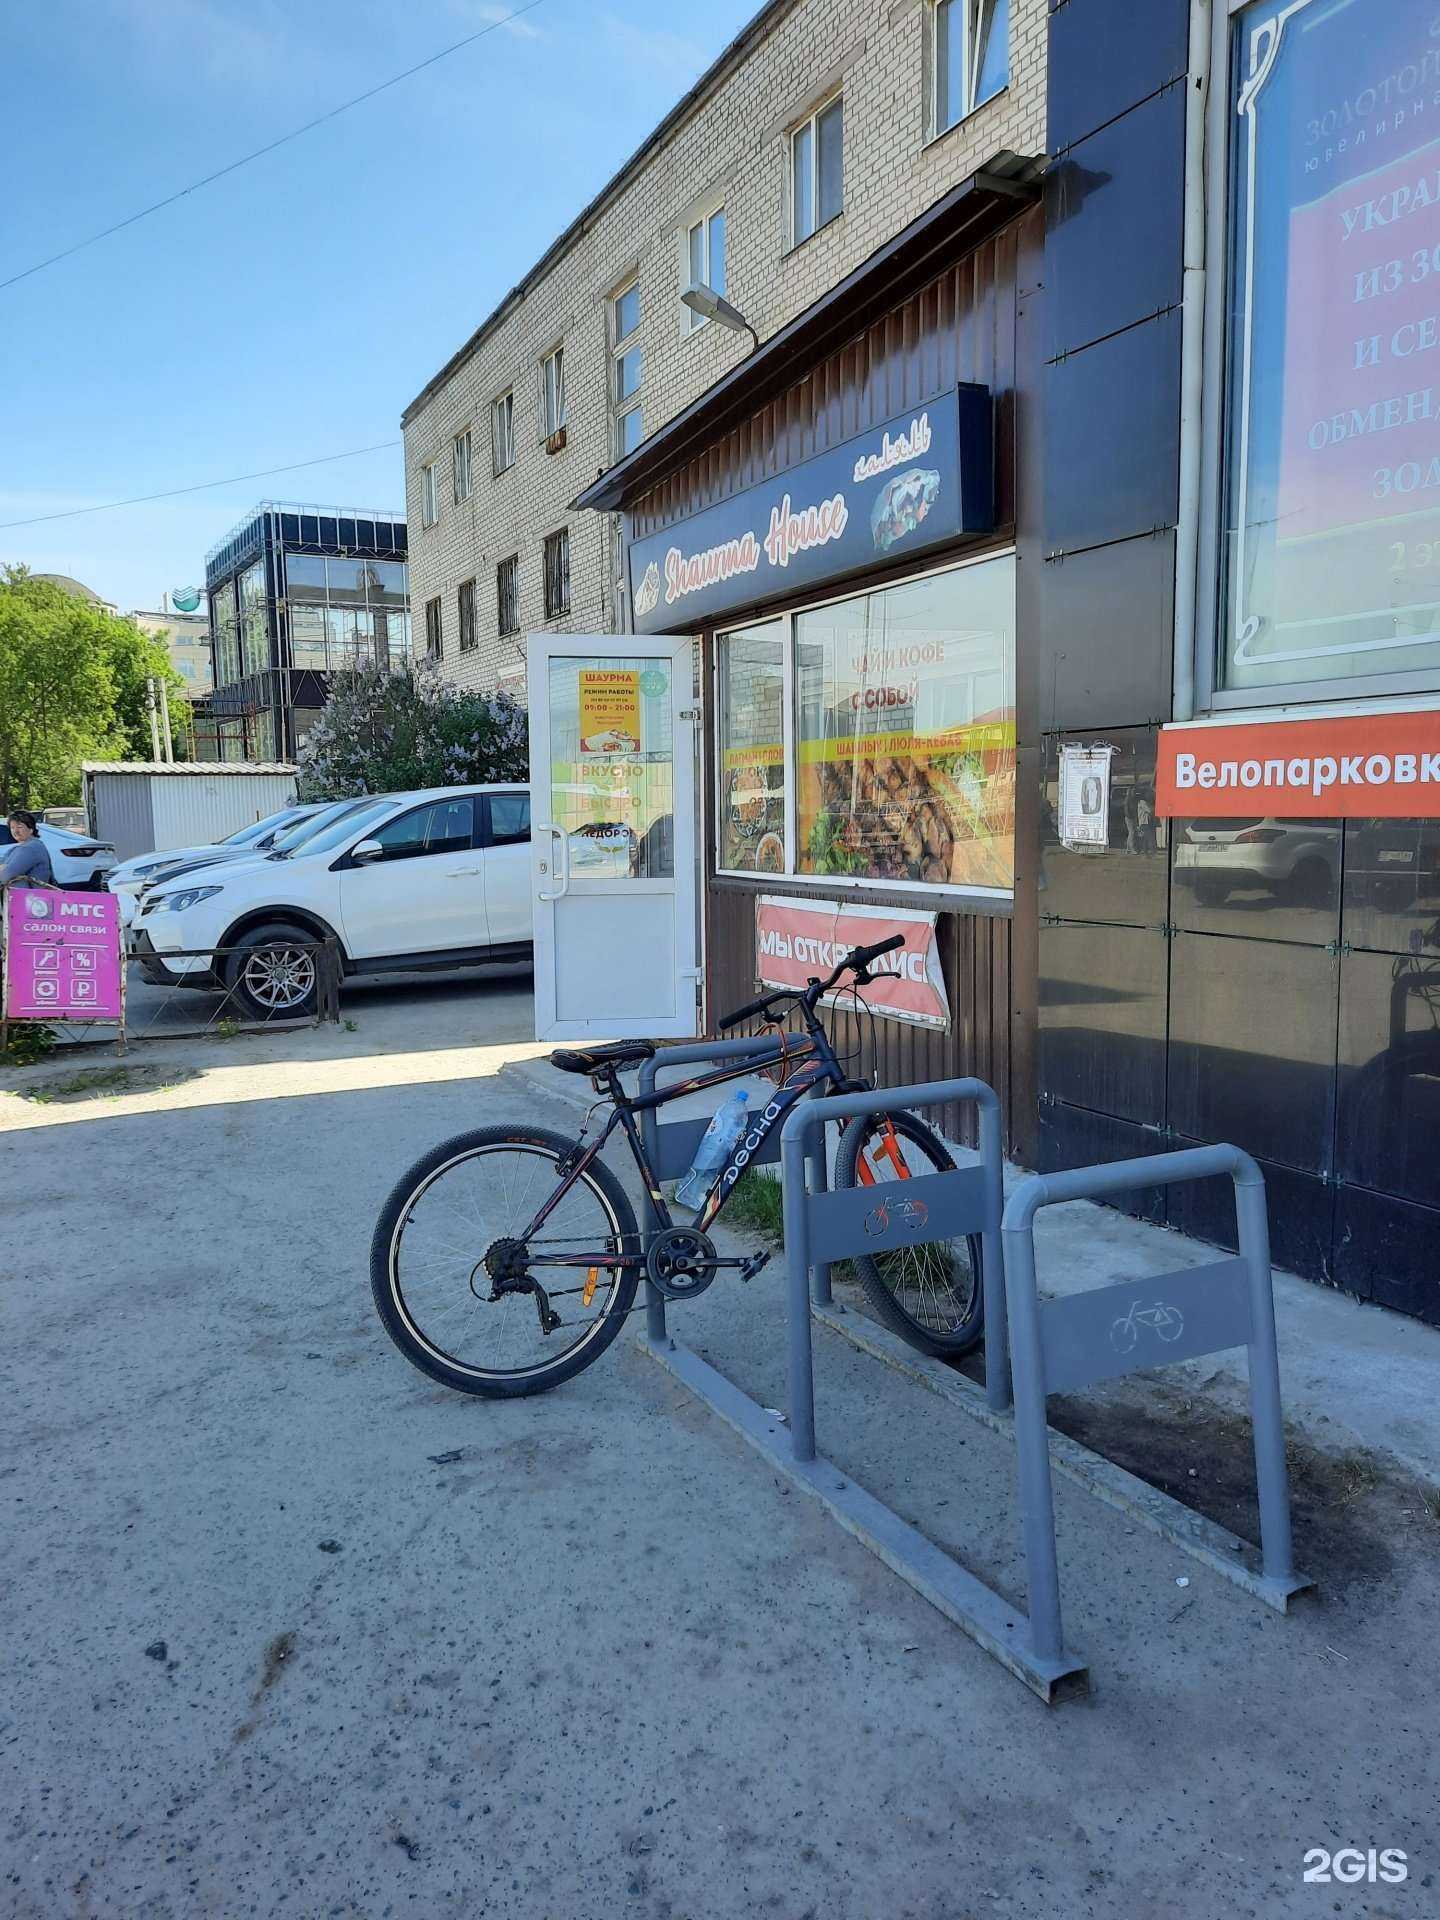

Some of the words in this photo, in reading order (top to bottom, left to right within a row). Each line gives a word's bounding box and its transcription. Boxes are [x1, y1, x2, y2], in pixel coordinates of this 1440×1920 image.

[1340, 170, 1440, 241] УКРА
[1352, 260, 1403, 304] ИЗ
[1352, 334, 1384, 370] И
[1391, 315, 1440, 357] СЕ
[1308, 387, 1440, 450] ОБМЕН
[764, 493, 849, 568] House
[852, 647, 880, 672] ЧАЙ
[884, 649, 895, 669] И
[899, 640, 944, 667] КОФЕ
[585, 673, 632, 682] ШАУРМА
[852, 691, 861, 711] С
[864, 674, 919, 709] СОБОЙ
[836, 738, 881, 755] ШАШЛЫК
[889, 735, 961, 752] ЛЮЛЯ-КЕБАБ
[582, 764, 644, 777] ВКУСНО
[1176, 753, 1440, 796] Велопарковк
[582, 797, 642, 809] БЫСТРО
[23, 923, 65, 933] салон
[69, 924, 107, 934] связи
[60, 903, 105, 917] МТС
[760, 929, 793, 959] МЫ
[794, 936, 928, 984] ОТКРЛИС
